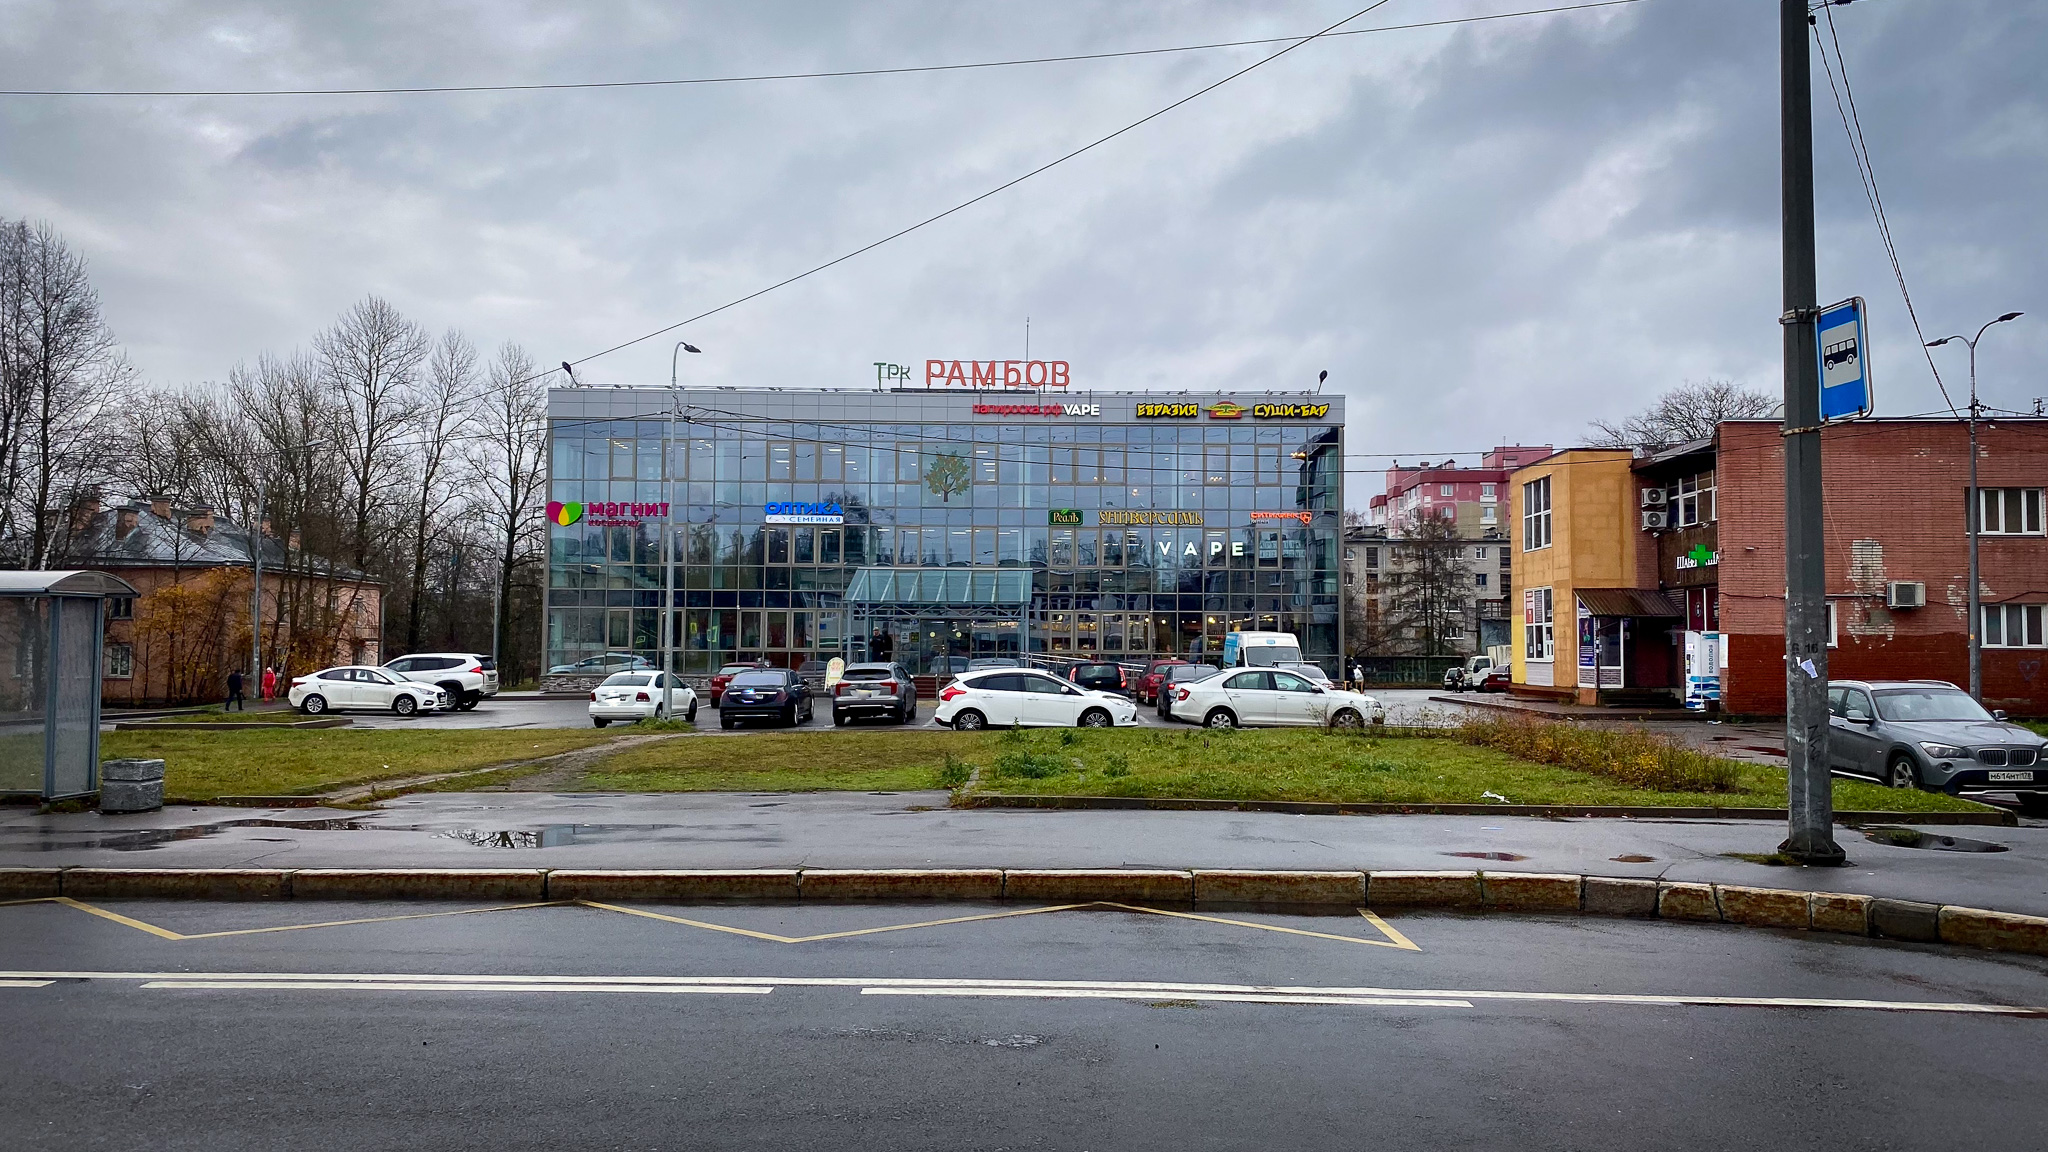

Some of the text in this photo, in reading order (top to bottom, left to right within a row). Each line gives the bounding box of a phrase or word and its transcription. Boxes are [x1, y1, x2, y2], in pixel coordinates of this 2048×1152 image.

[926, 360, 1070, 387] РАМБОВ
[1063, 404, 1100, 416] VAPE
[1137, 404, 1198, 417] ЕВРАЗИЯ
[1254, 403, 1330, 418] СУШИ-БАР
[764, 502, 844, 515] ОПТИКА
[1158, 541, 1244, 556] VAPE
